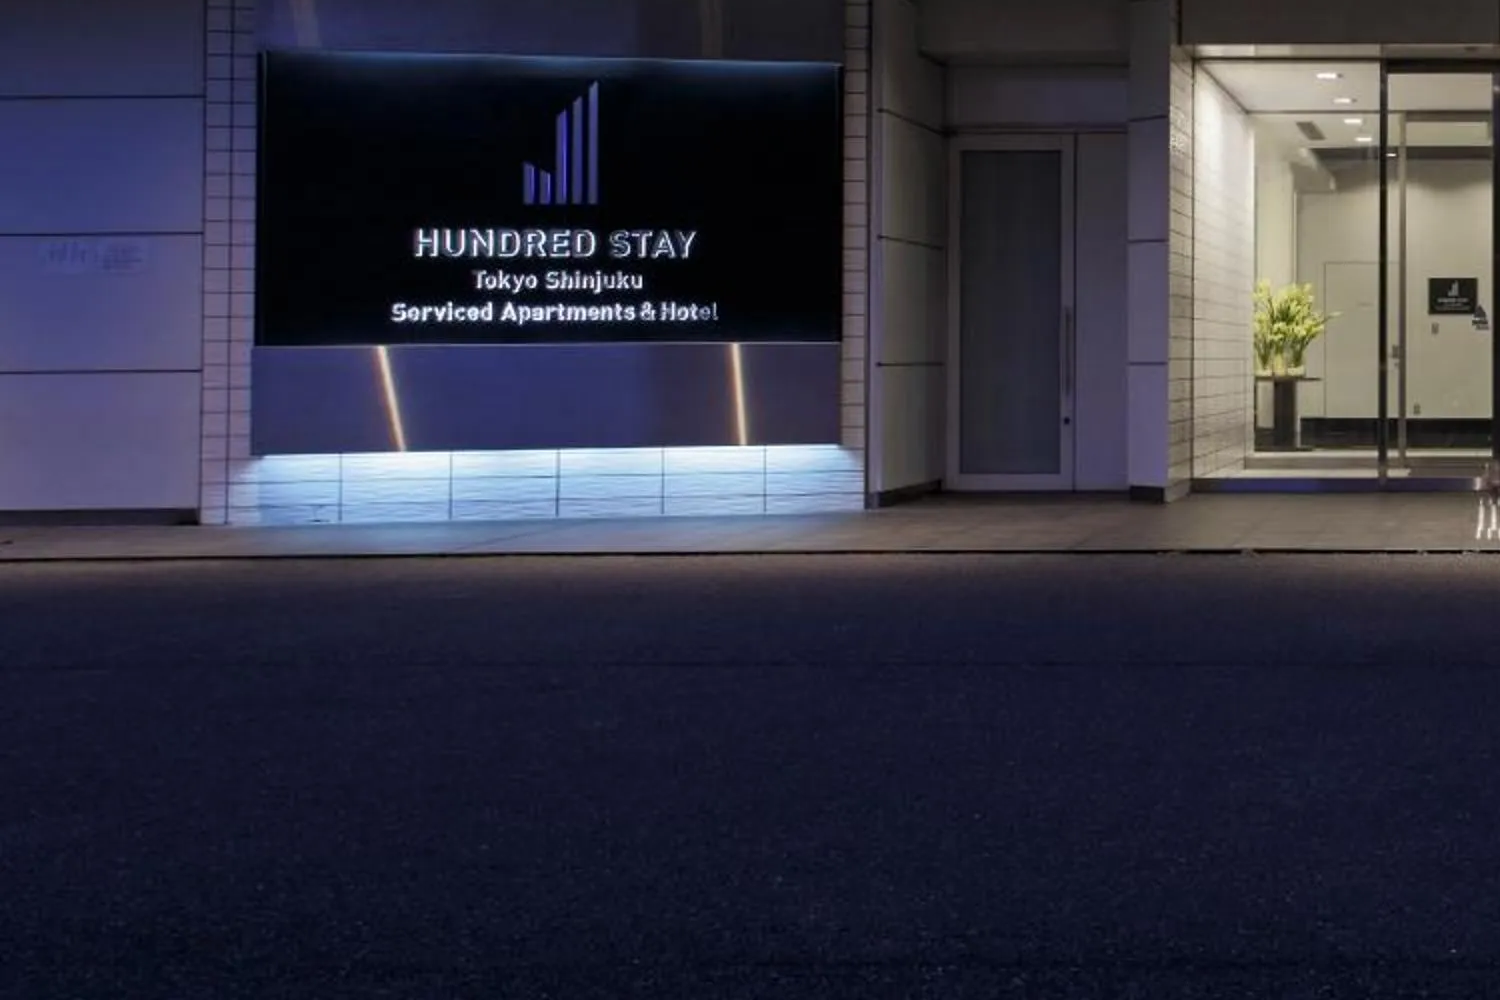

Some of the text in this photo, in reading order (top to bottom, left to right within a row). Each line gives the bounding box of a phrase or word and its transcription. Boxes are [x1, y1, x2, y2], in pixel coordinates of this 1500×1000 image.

[414, 227, 698, 260] HUNDRED STAY
[472, 269, 644, 294] Tokyo Shinjuku
[391, 302, 494, 323] Serviced
[500, 301, 637, 326] Apartments
[658, 301, 720, 322] Hotel
